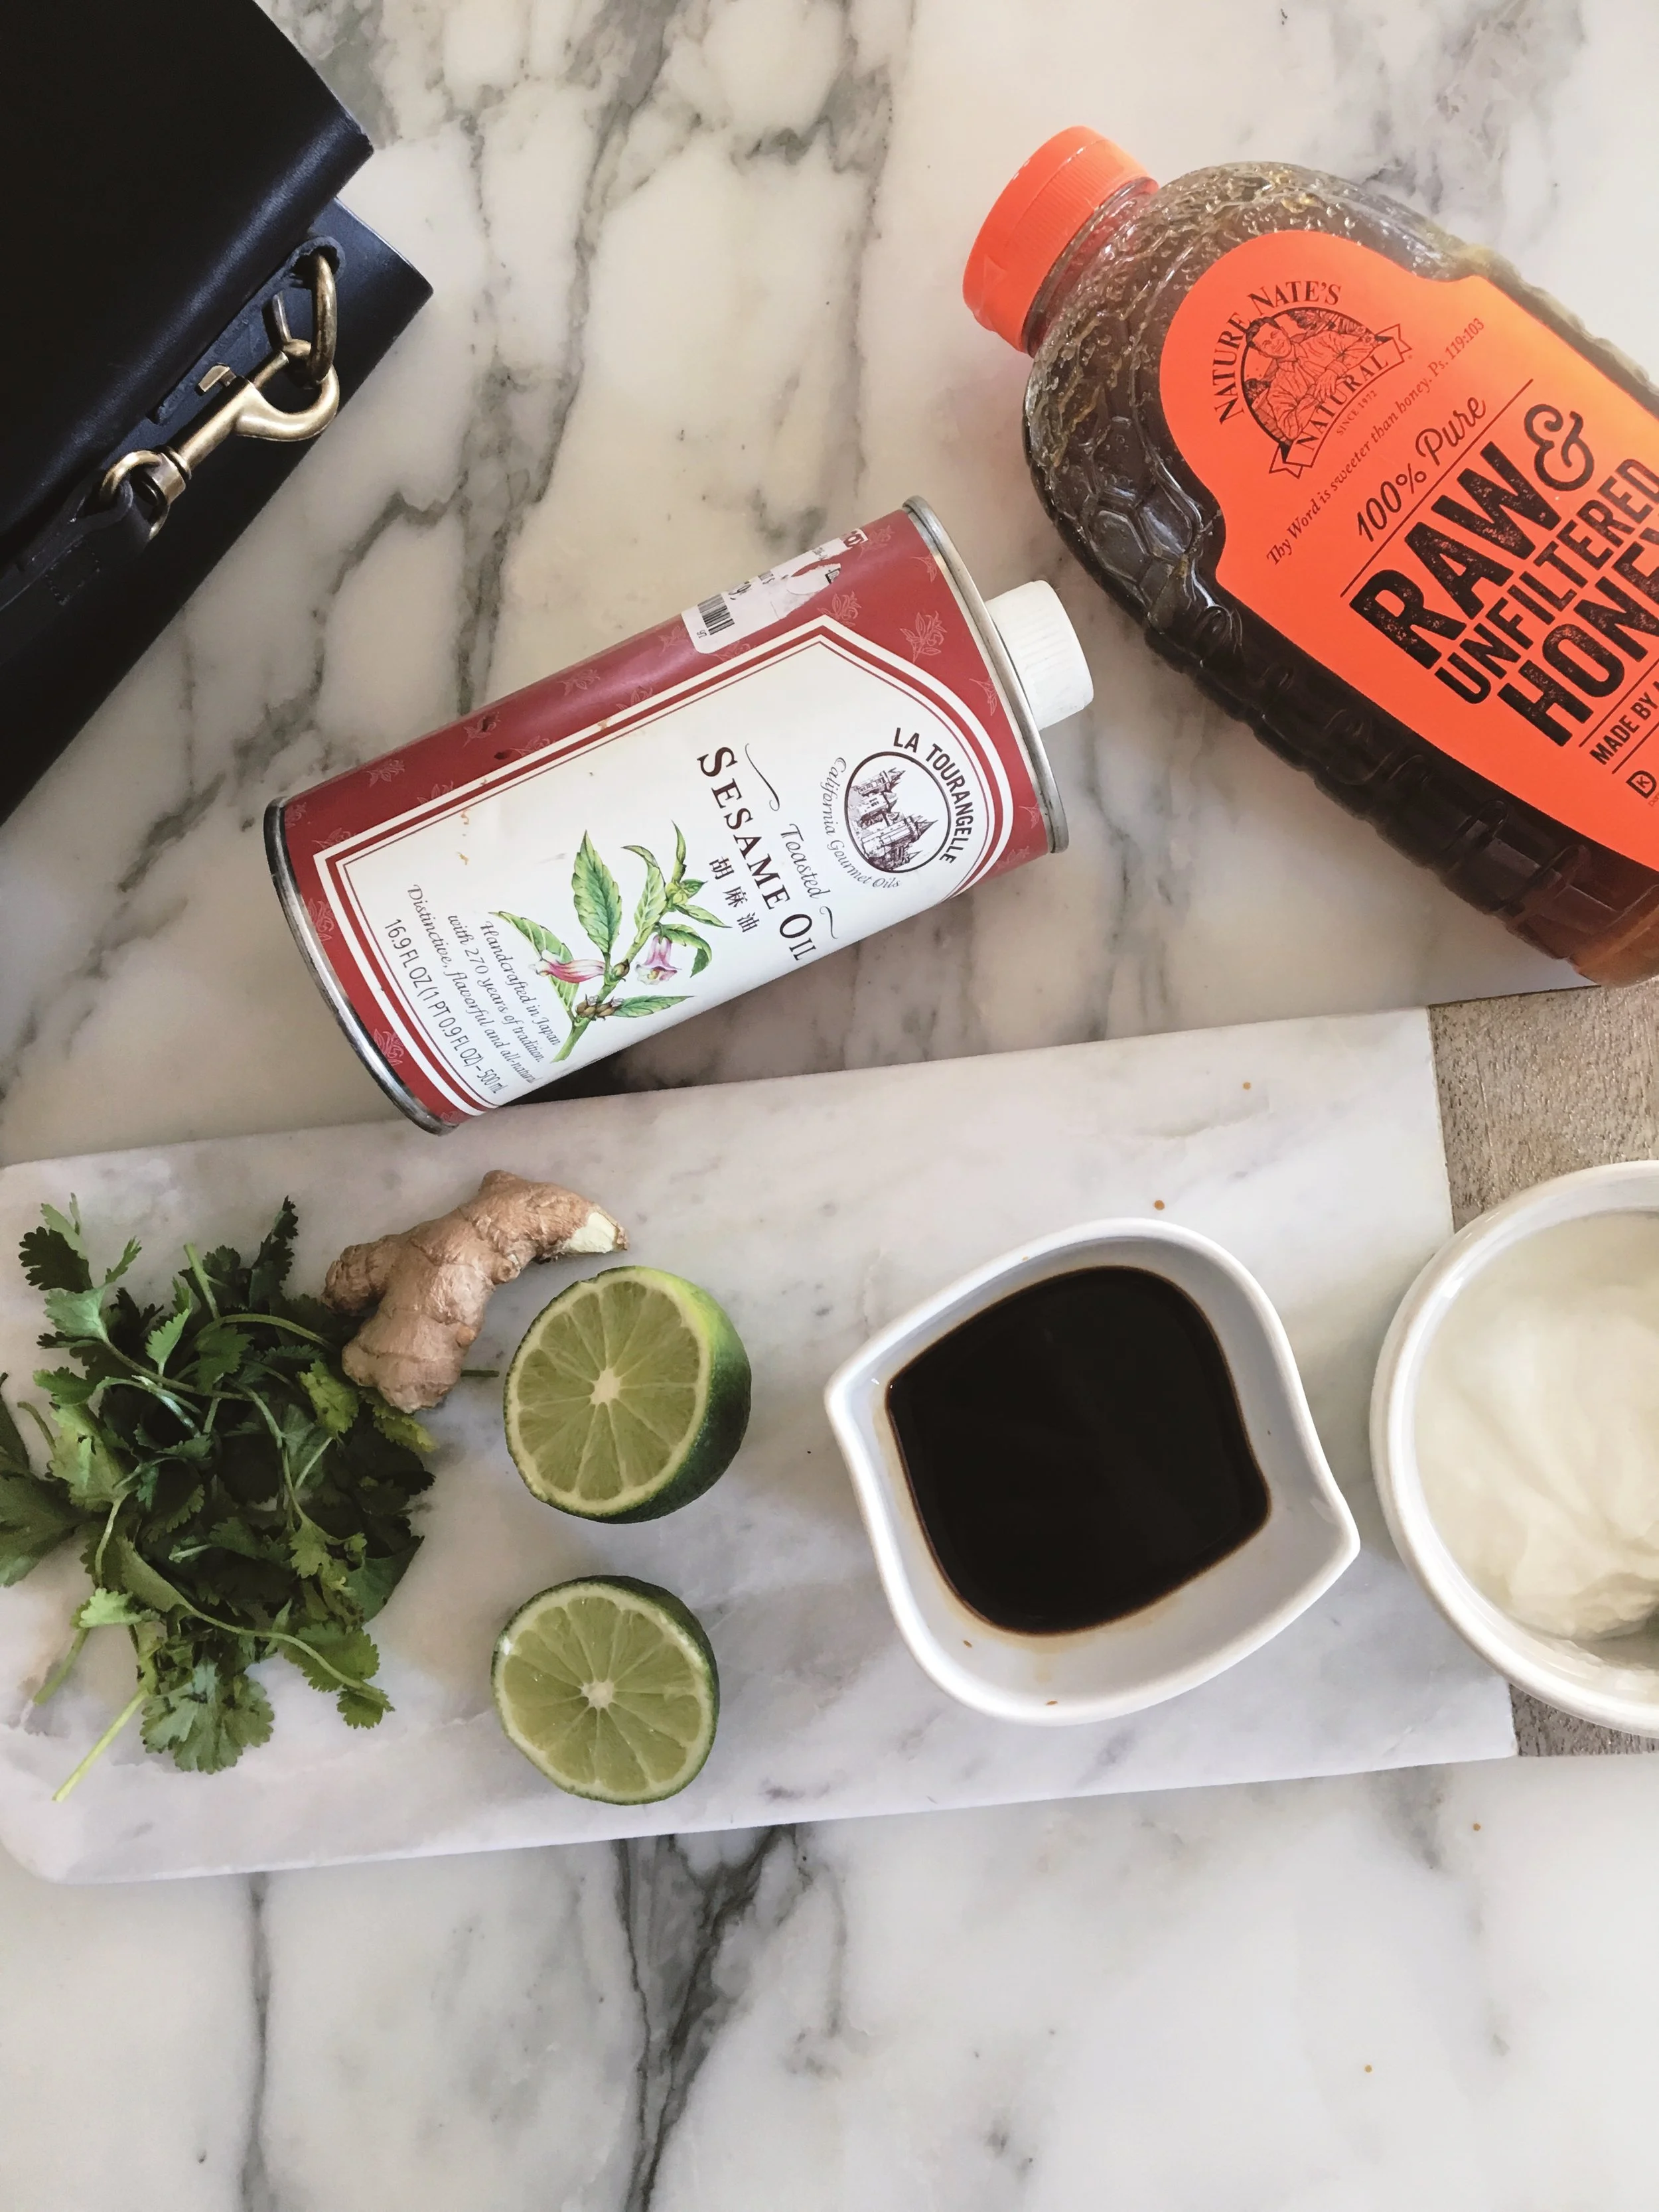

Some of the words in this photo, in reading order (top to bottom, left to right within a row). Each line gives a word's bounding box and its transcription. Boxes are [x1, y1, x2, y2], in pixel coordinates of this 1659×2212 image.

[1212, 312, 1251, 425] NATURE
[1247, 281, 1342, 317] NATE'S
[1295, 353, 1388, 451] NATURAL
[1336, 406, 1360, 435] SINCE
[1265, 538, 1293, 565] Thy
[1286, 498, 1321, 539] Word
[1317, 490, 1331, 504] is
[1331, 441, 1370, 491] sweeter
[1371, 412, 1399, 443] than
[1394, 378, 1433, 417] honey.
[1427, 360, 1449, 377] Ps.
[1444, 318, 1484, 360] 119:103
[1357, 463, 1427, 542] 100%
[1415, 397, 1486, 466] Pure
[1350, 441, 1561, 670] RAW
[1524, 404, 1595, 491] &
[1434, 459, 1659, 704] UNFILTERED
[1497, 527, 1659, 747] HONE
[1589, 715, 1640, 765] MADE
[1630, 692, 1658, 721] BY
[820, 757, 847, 836] California
[893, 727, 920, 753] LA
[926, 743, 974, 863] TOURANGELLE
[697, 747, 791, 910] SESAME
[780, 824, 831, 899] Toasted
[827, 840, 872, 884] Gourmet
[872, 877, 901, 888] Oils
[385, 919, 412, 950] 16.9
[448, 915, 474, 946] with
[399, 950, 419, 968] FL
[407, 884, 453, 968] Distinctive,
[443, 971, 490, 1027] flavorful
[484, 1027, 510, 1051] and
[465, 948, 488, 974] 270
[480, 921, 530, 1005] Handcrafted
[409, 966, 432, 989] OZ
[417, 986, 440, 1003] (1
[476, 977, 508, 1013] years
[428, 999, 451, 1018] PT
[504, 1011, 519, 1026] of
[526, 999, 540, 1017] in
[439, 1017, 463, 1037] 0.9
[452, 1035, 470, 1052] FL
[512, 1023, 545, 1063] tradition.
[532, 1017, 561, 1047] Japan
[460, 1047, 483, 1067] OZ)
[476, 1069, 497, 1085] 500
